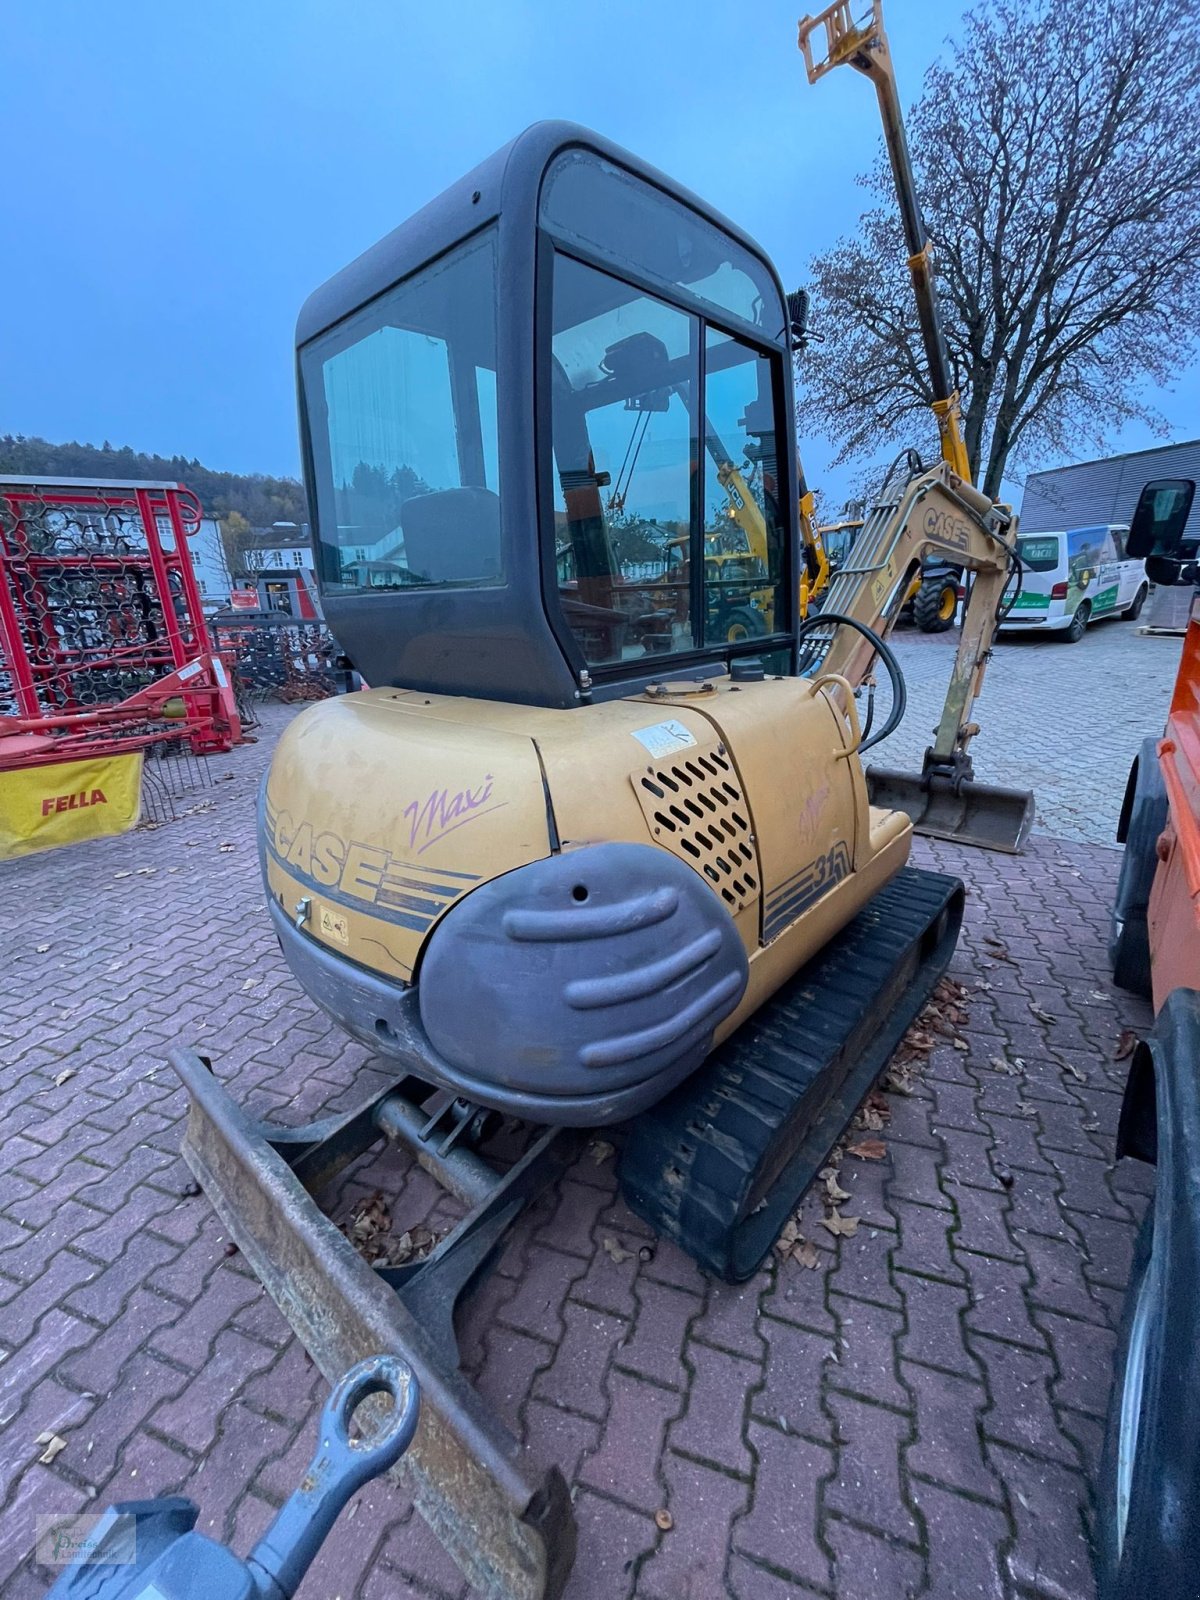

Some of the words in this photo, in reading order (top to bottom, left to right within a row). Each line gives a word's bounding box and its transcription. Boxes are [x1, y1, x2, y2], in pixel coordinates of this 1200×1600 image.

[727, 482, 744, 510] JCB
[923, 507, 964, 542] CASE
[42, 788, 108, 817] FELLA
[403, 773, 496, 850] Maxi
[273, 808, 393, 903] CASE
